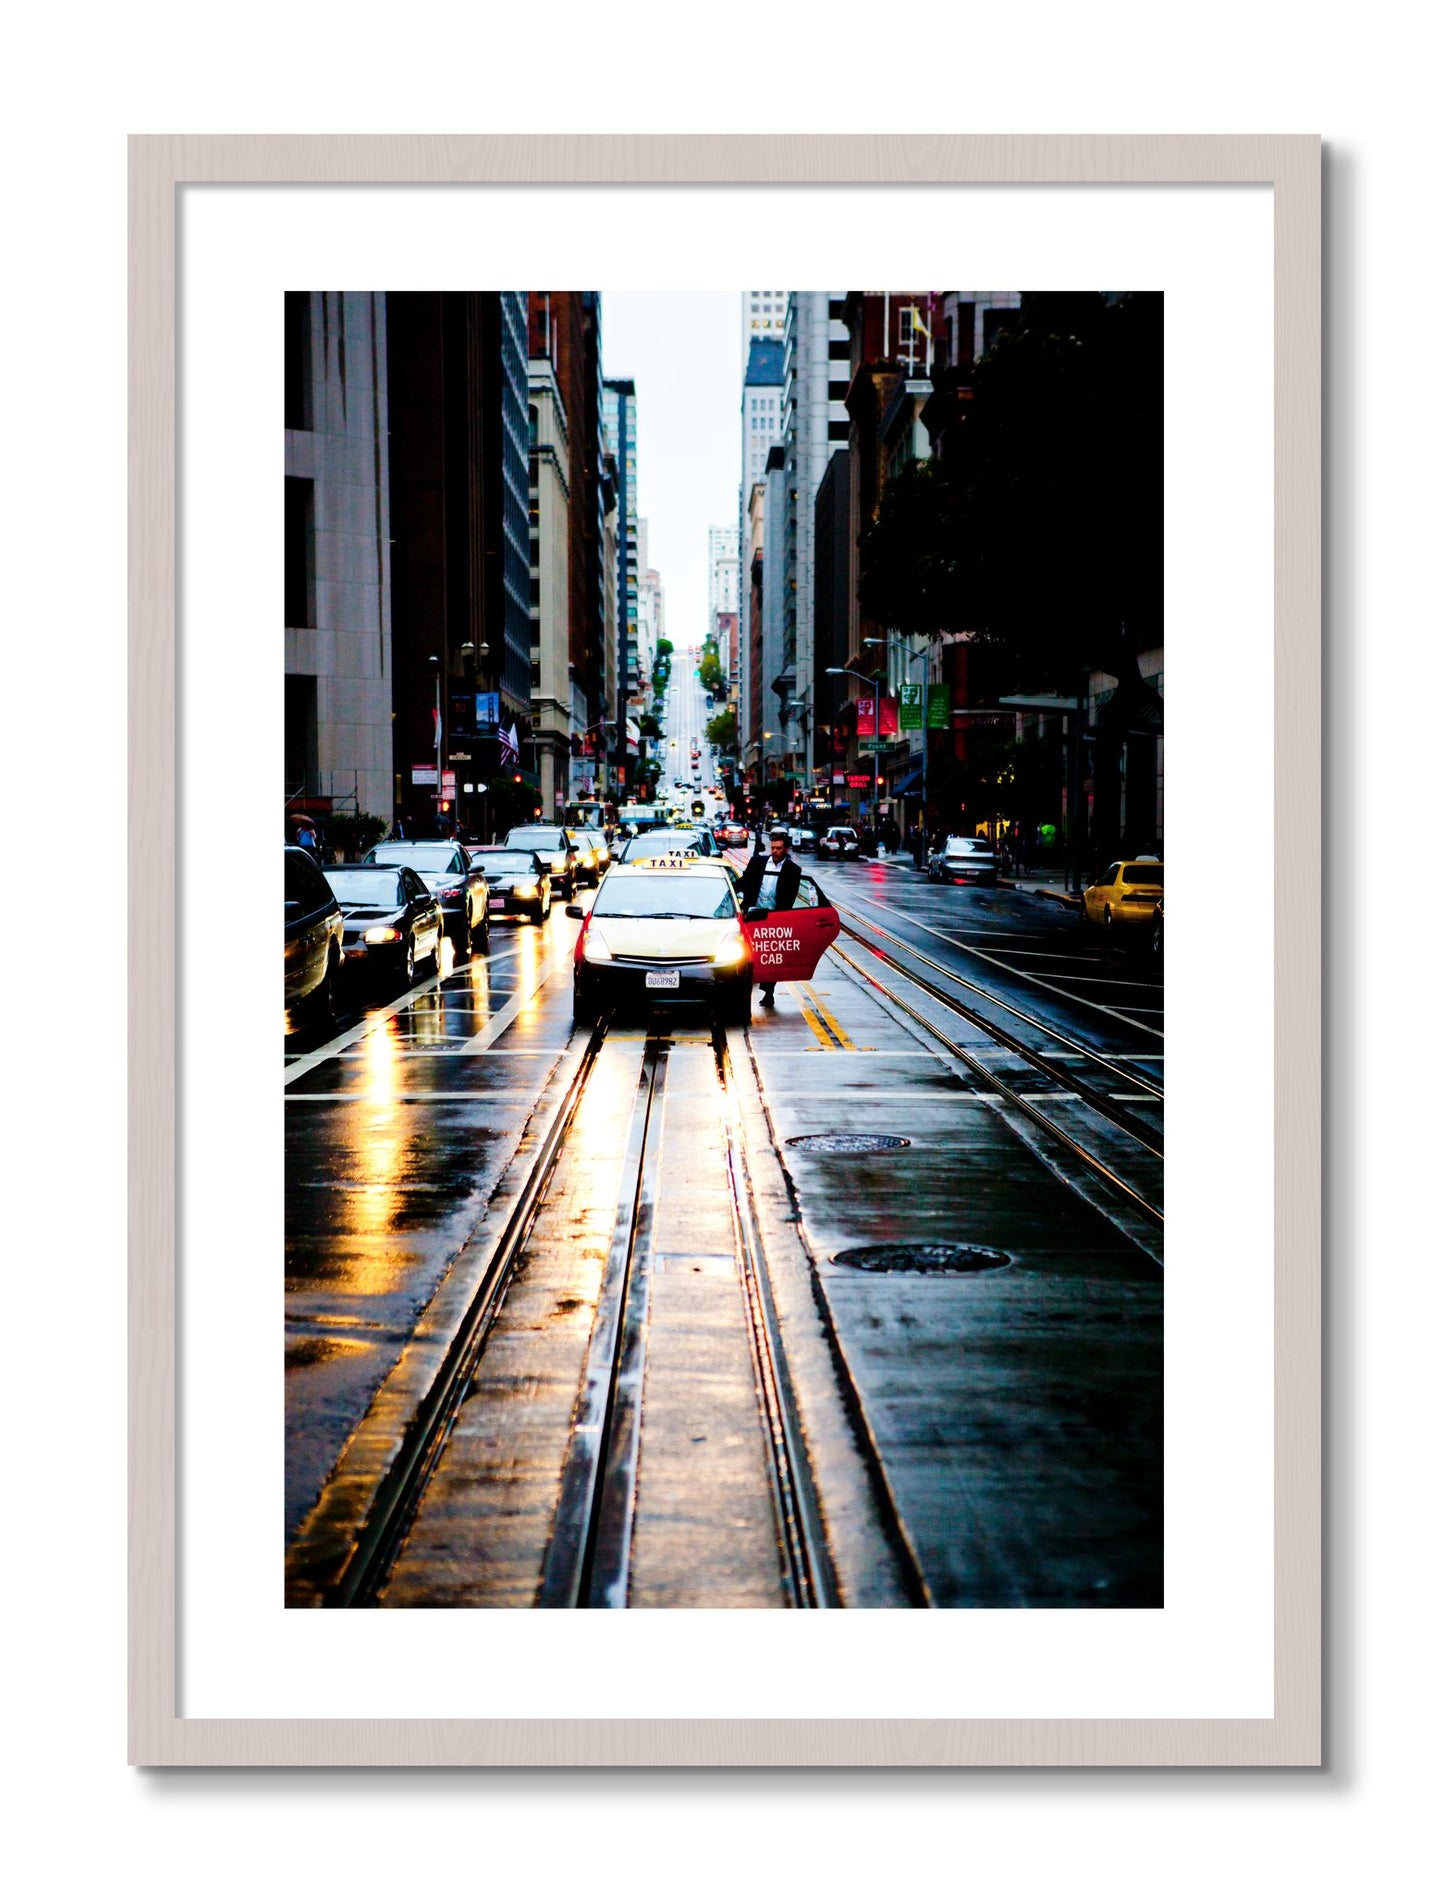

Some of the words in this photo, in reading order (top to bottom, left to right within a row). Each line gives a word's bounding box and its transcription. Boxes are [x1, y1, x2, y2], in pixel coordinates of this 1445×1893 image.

[650, 859, 683, 868] TAXI
[753, 927, 793, 939] ARROW
[760, 953, 783, 965] CAB
